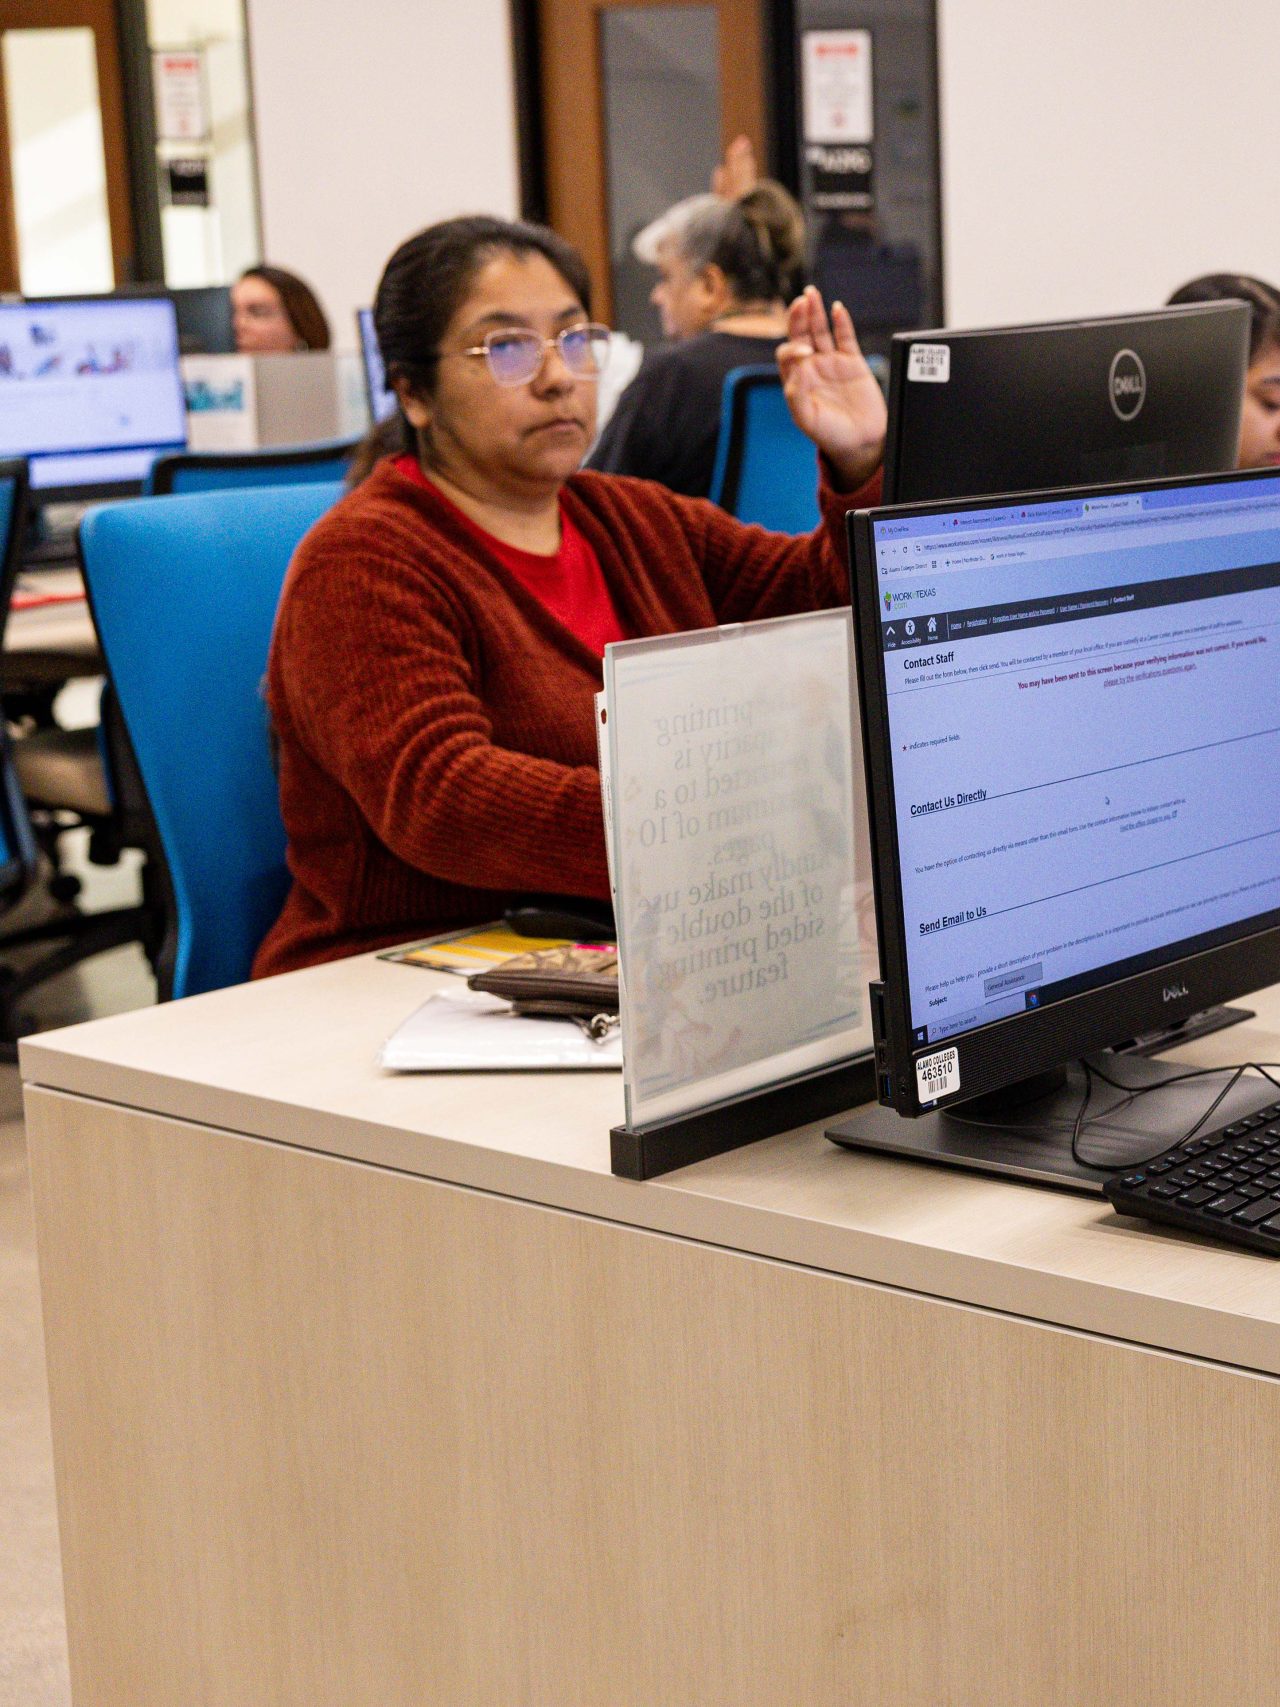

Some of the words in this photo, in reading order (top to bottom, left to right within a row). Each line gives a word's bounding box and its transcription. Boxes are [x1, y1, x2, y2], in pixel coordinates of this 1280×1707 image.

[1112, 374, 1142, 395] DELL
[900, 636, 921, 647] Accessibility
[903, 654, 934, 671] Contact
[935, 650, 954, 665] Staff
[904, 675, 919, 686] Please
[942, 669, 953, 679] form
[953, 666, 968, 677] below,
[967, 664, 979, 674] then
[978, 662, 988, 672] click
[988, 660, 1000, 670] send.
[1022, 652, 1043, 664] contacted
[1051, 647, 1069, 659] member
[1017, 680, 1028, 691] You
[1028, 678, 1040, 689] may
[1040, 675, 1054, 687] have
[1054, 672, 1068, 684] been
[1068, 670, 1079, 681] sent
[1086, 667, 1096, 678] this
[1096, 663, 1113, 676] screen
[1113, 659, 1133, 672] because
[1133, 657, 1145, 668] your
[1145, 653, 1167, 667] verifying
[1103, 676, 1119, 688] please
[909, 739, 929, 751] indicates
[929, 735, 948, 747] required
[909, 797, 943, 816] Contact
[943, 794, 955, 807] Us
[956, 786, 987, 807] Directly
[914, 865, 924, 876] You
[924, 862, 935, 873] have
[943, 855, 958, 868] option
[963, 848, 986, 863] contacting
[991, 842, 1007, 855] directly
[919, 918, 941, 934] Send
[941, 911, 965, 928] Email
[966, 908, 974, 920] to
[975, 904, 987, 917] Us
[924, 982, 939, 995] Please
[939, 978, 949, 990] help
[955, 973, 965, 985] help
[977, 964, 994, 978] provide
[997, 959, 1008, 971] short
[1008, 952, 1031, 967] description
[987, 979, 1004, 992] General
[1162, 982, 1189, 1001] DELL
[928, 994, 947, 1009] Subject:
[963, 1013, 977, 1026] search
[917, 1058, 932, 1070] ALAMO
[933, 1050, 956, 1066] COLLEGES
[922, 1061, 953, 1081] 463510
